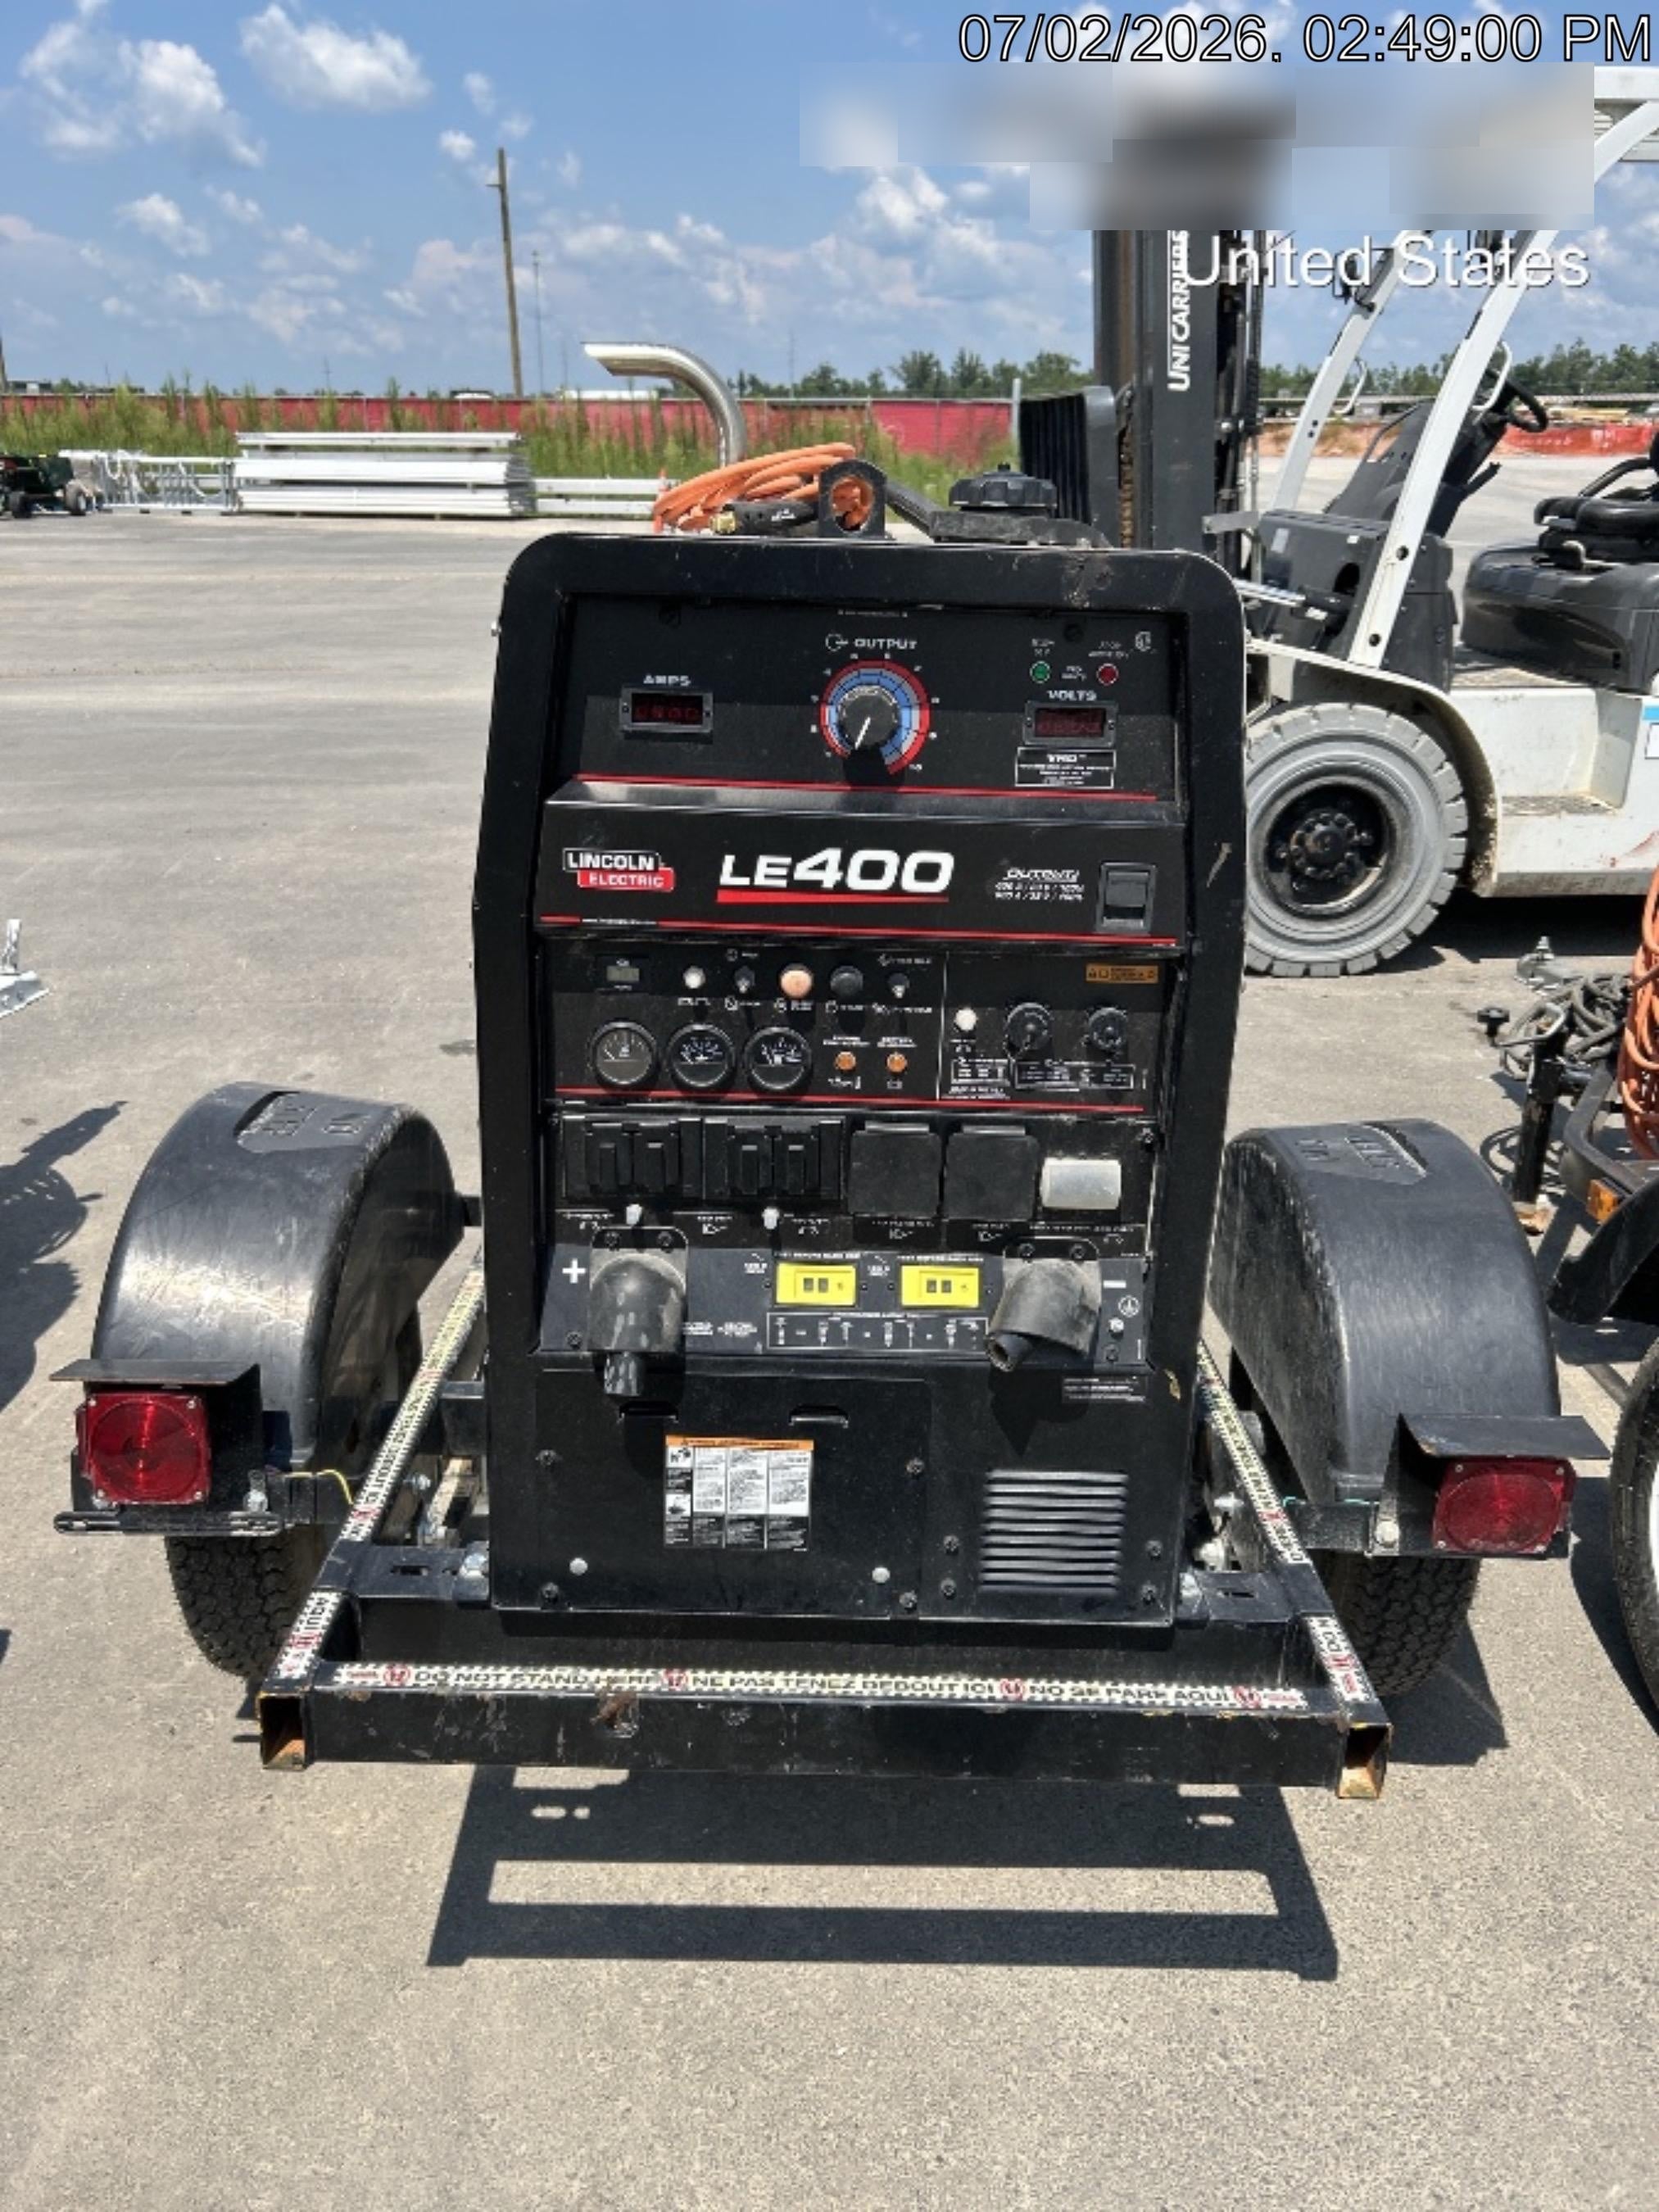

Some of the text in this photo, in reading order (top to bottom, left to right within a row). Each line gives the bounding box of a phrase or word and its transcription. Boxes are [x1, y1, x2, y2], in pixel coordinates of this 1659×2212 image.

[854, 637, 918, 650] OUTPUT
[643, 674, 691, 687] AMPS
[1046, 690, 1098, 701] VOLTS
[567, 852, 655, 871] LINCOLN
[719, 847, 955, 893] LE400
[588, 873, 664, 888] ELECTRIC
[415, 1671, 450, 1682] DO
[456, 1672, 506, 1682] NOT
[693, 1675, 723, 1687] NE
[863, 1680, 959, 1693] DEBOUT
[1030, 1685, 1064, 1696] NO
[1175, 1690, 1229, 1702] AQUI
